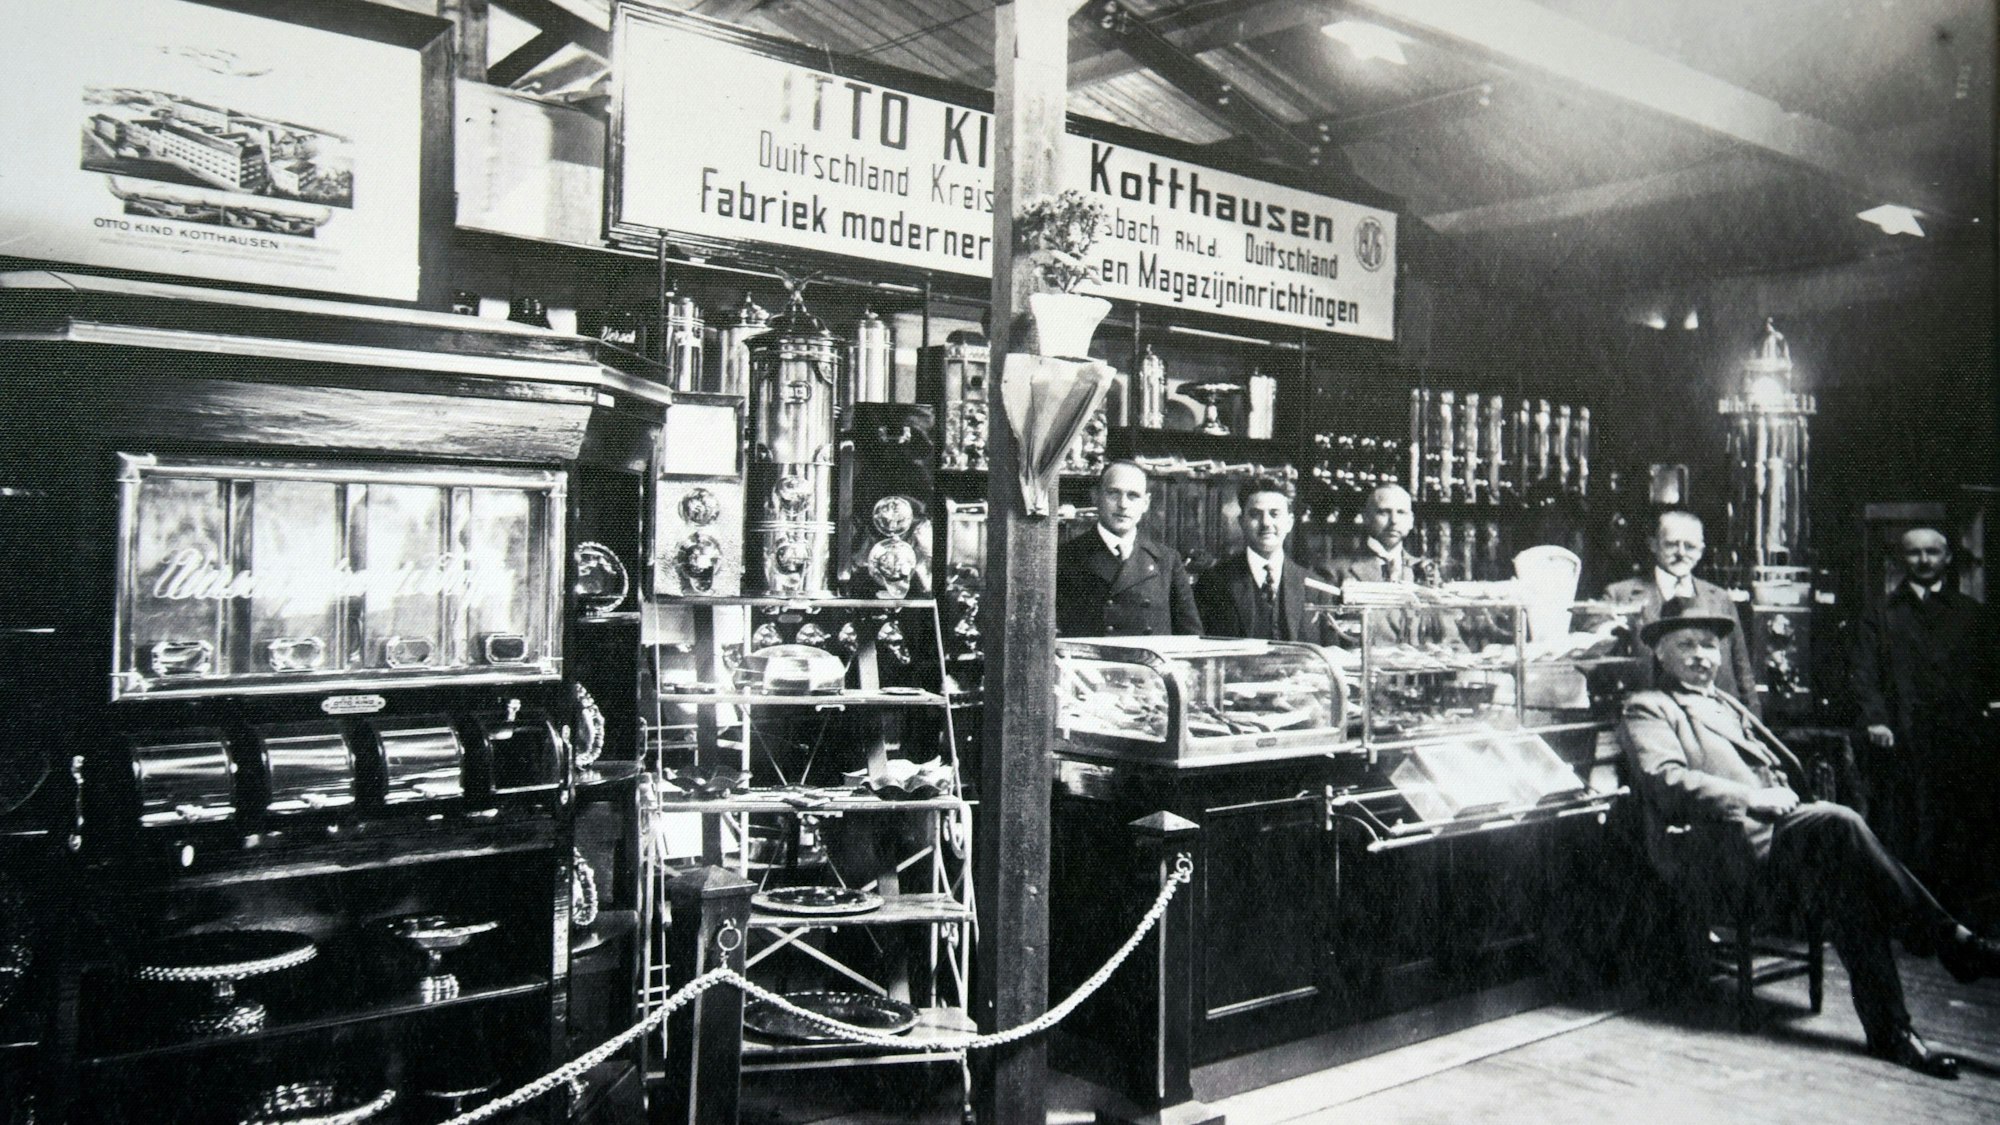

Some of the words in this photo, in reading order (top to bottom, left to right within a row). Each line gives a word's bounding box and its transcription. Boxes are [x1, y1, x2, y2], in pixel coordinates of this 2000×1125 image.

[760, 129, 909, 197] Duitschland
[944, 106, 988, 168] KI
[1090, 142, 1333, 243] Kotthausen
[93, 217, 131, 231] OTTO
[134, 224, 173, 236] KIND
[180, 230, 280, 249] KOTTHAUSEN
[701, 166, 827, 234] Fabriek
[842, 210, 991, 260] moderner
[1102, 258, 1128, 285] en
[1138, 250, 1360, 327] Magazijninrichtingen
[1245, 232, 1338, 280] Duitschland
